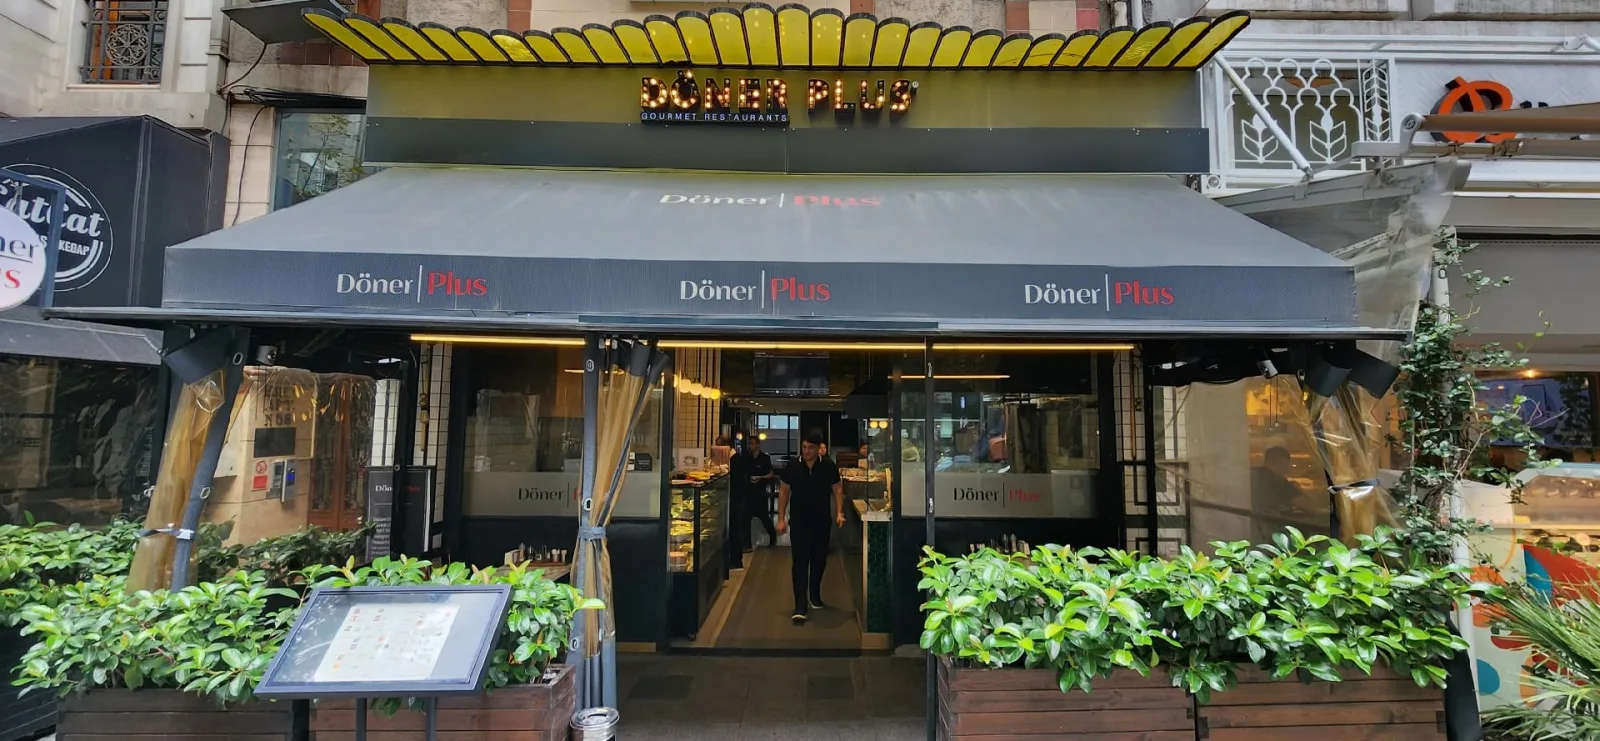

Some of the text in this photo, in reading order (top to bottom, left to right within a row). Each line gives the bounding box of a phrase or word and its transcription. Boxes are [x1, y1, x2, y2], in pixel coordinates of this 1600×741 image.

[641, 69, 912, 112] DÖNER PLUS
[641, 112, 788, 122] GOURMET RESTAURANTS
[660, 194, 881, 206] Döner Plus
[58, 239, 90, 256] KEBAP
[337, 271, 488, 296] Döner Plus
[680, 277, 831, 301] Döner Plus
[1024, 280, 1174, 305] Döner Plus
[518, 487, 564, 501] Döner
[953, 487, 999, 501] Döner
